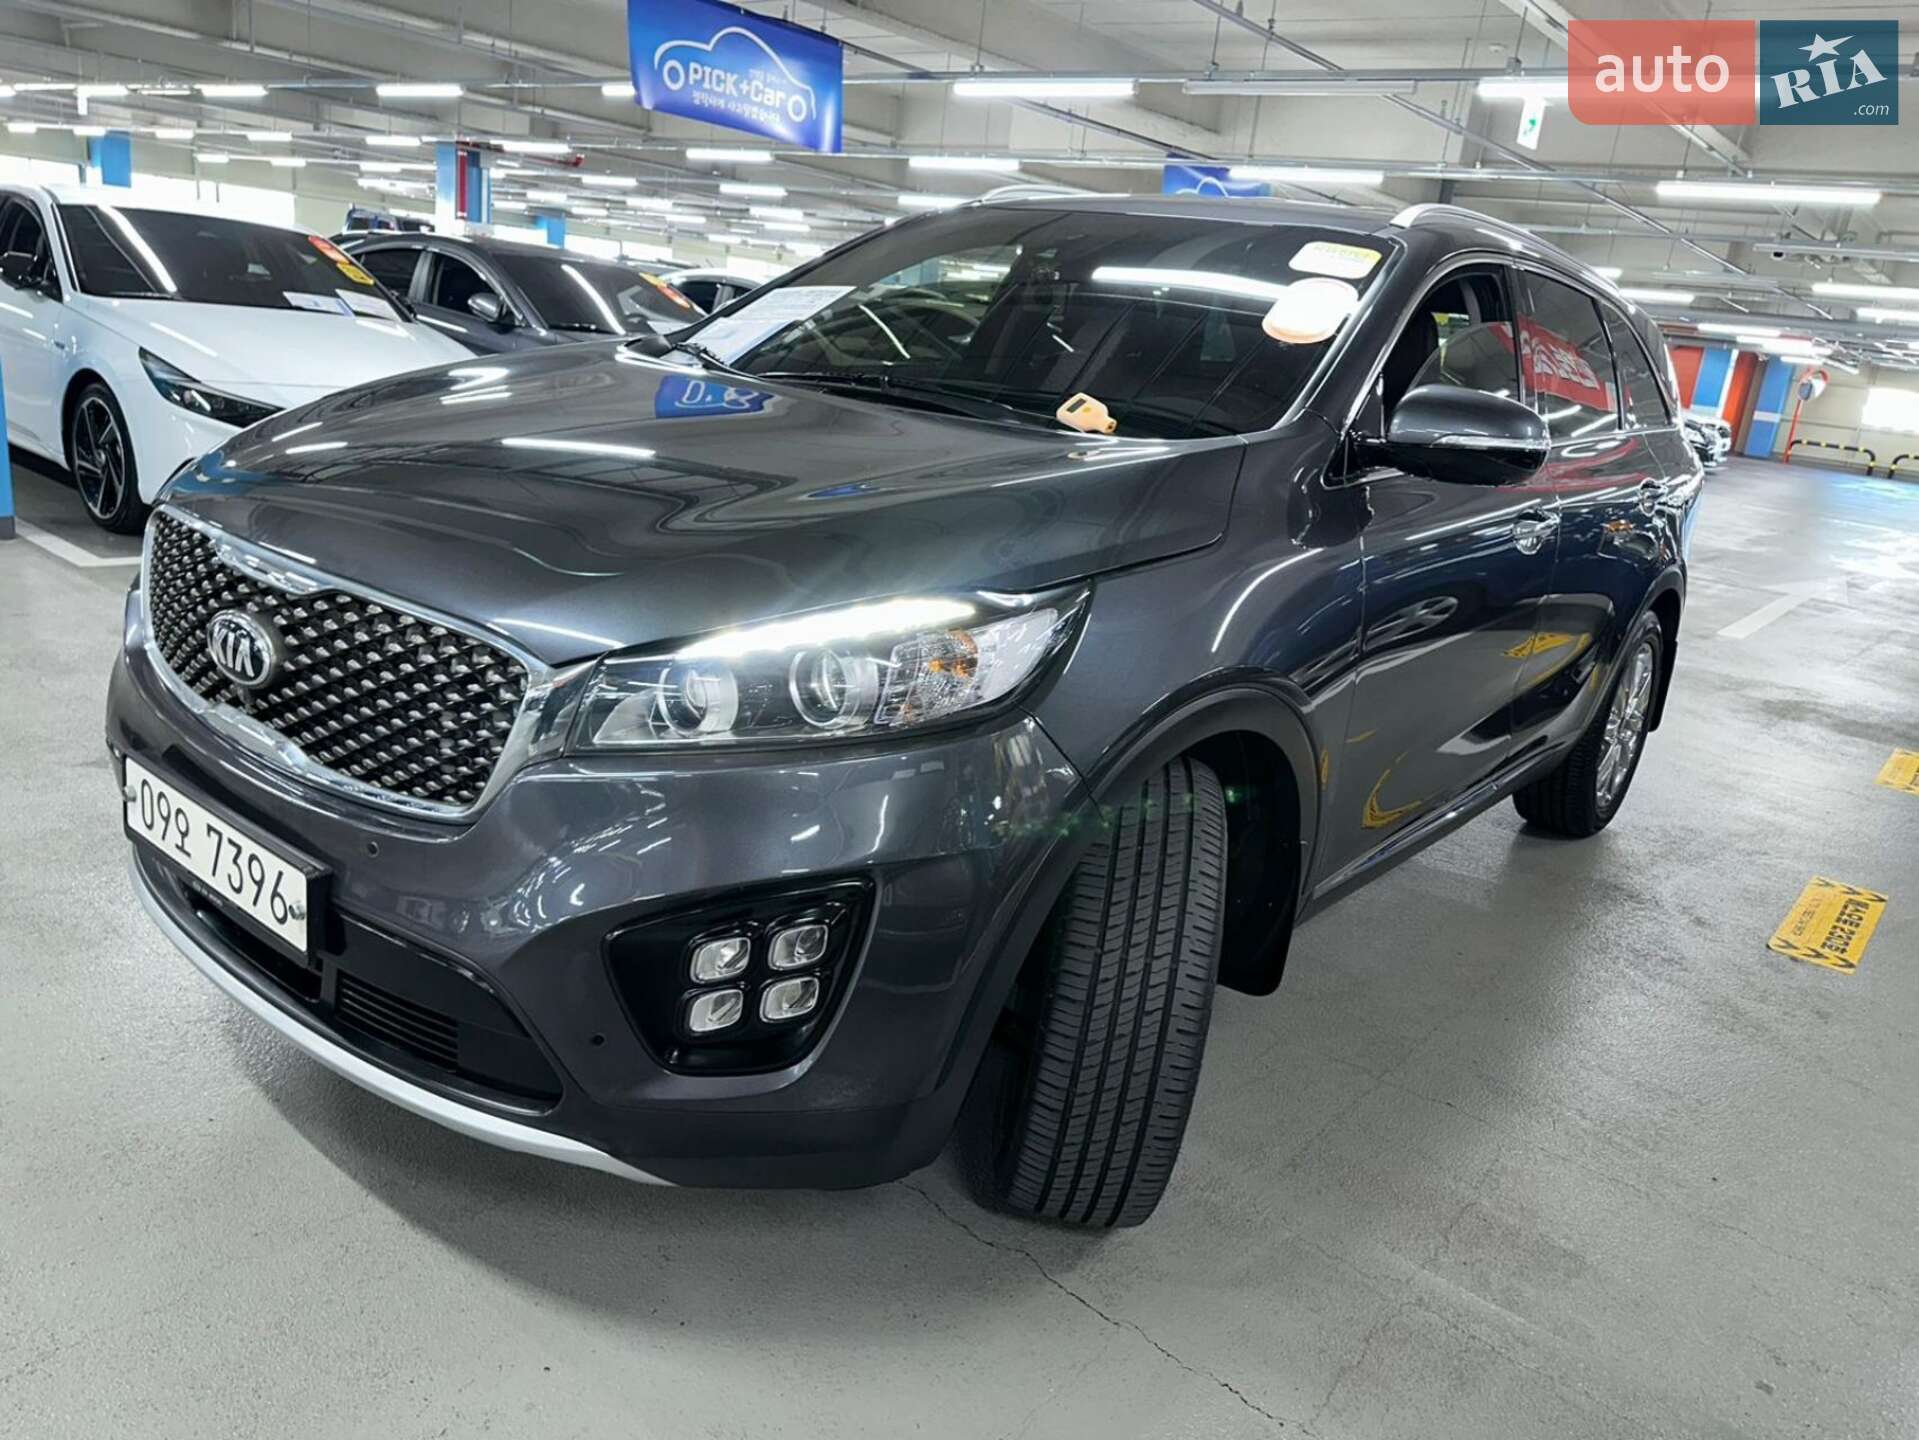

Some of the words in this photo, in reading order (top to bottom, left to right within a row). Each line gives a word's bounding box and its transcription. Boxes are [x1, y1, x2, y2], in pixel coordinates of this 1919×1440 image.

[213, 618, 256, 678] KIA
[141, 778, 192, 858] 09오
[206, 822, 289, 926] 7396
